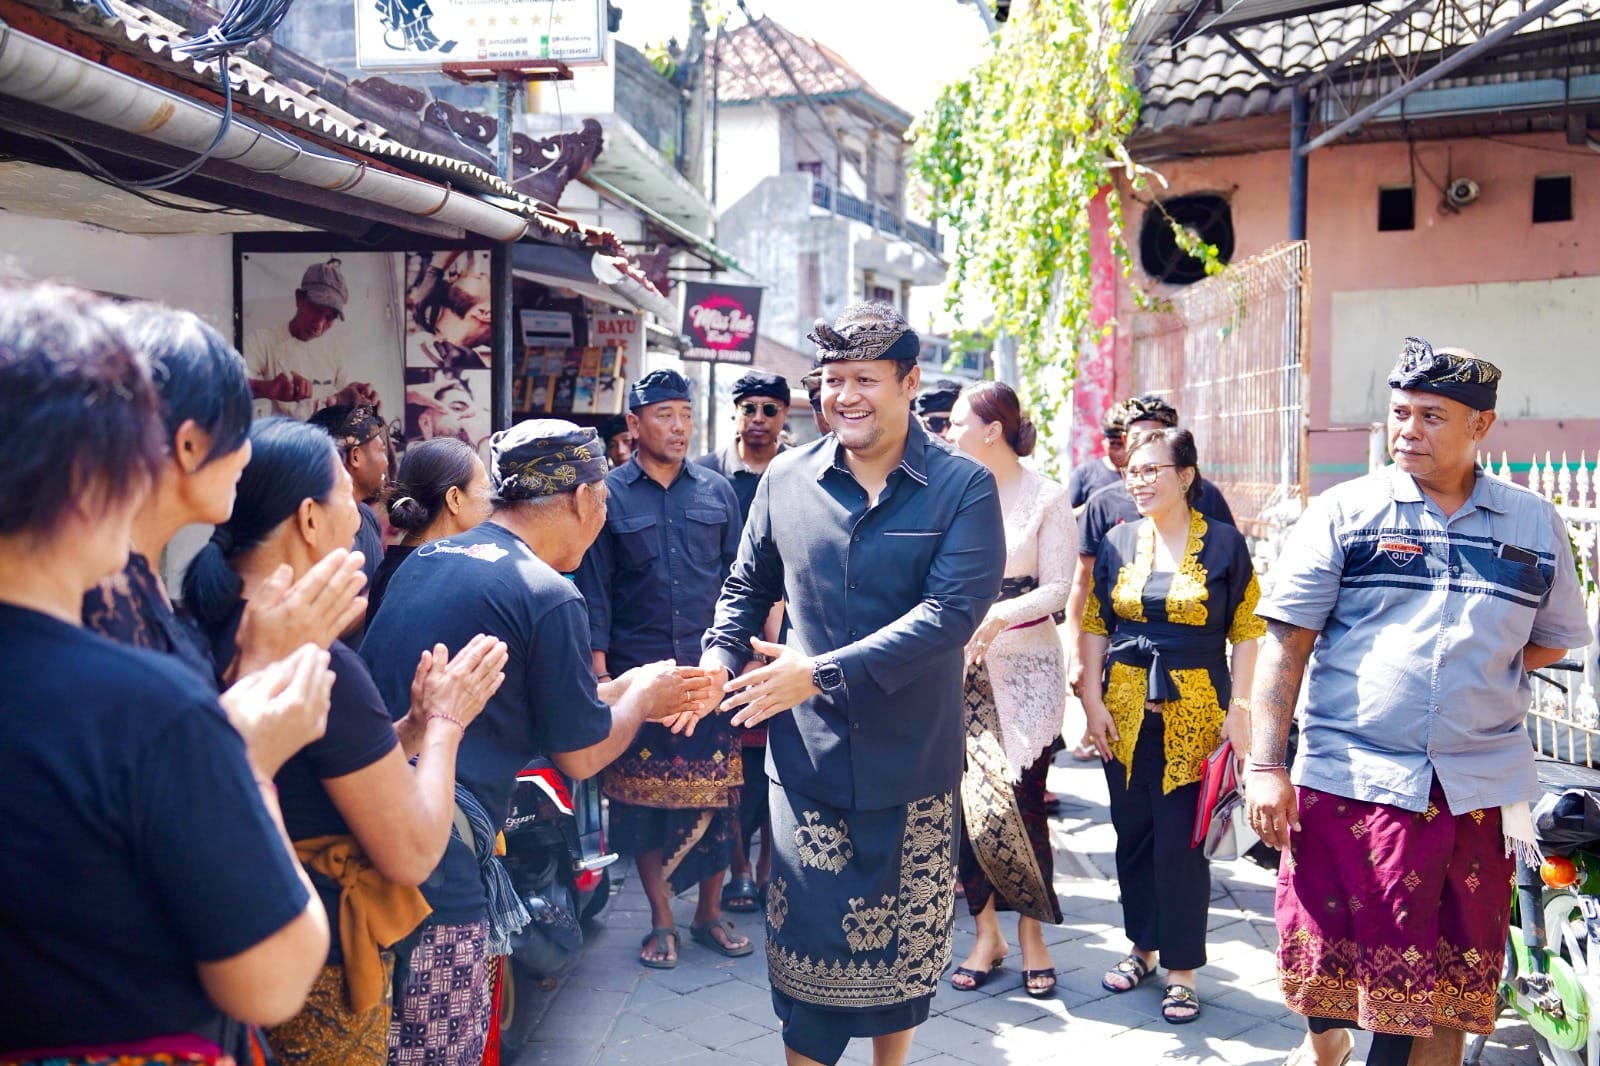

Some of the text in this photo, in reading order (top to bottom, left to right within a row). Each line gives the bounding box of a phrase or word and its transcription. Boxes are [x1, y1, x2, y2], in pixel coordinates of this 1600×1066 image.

[597, 320, 636, 334] BAYU
[718, 349, 751, 362] STUDIO
[1391, 552, 1409, 560] OIL
